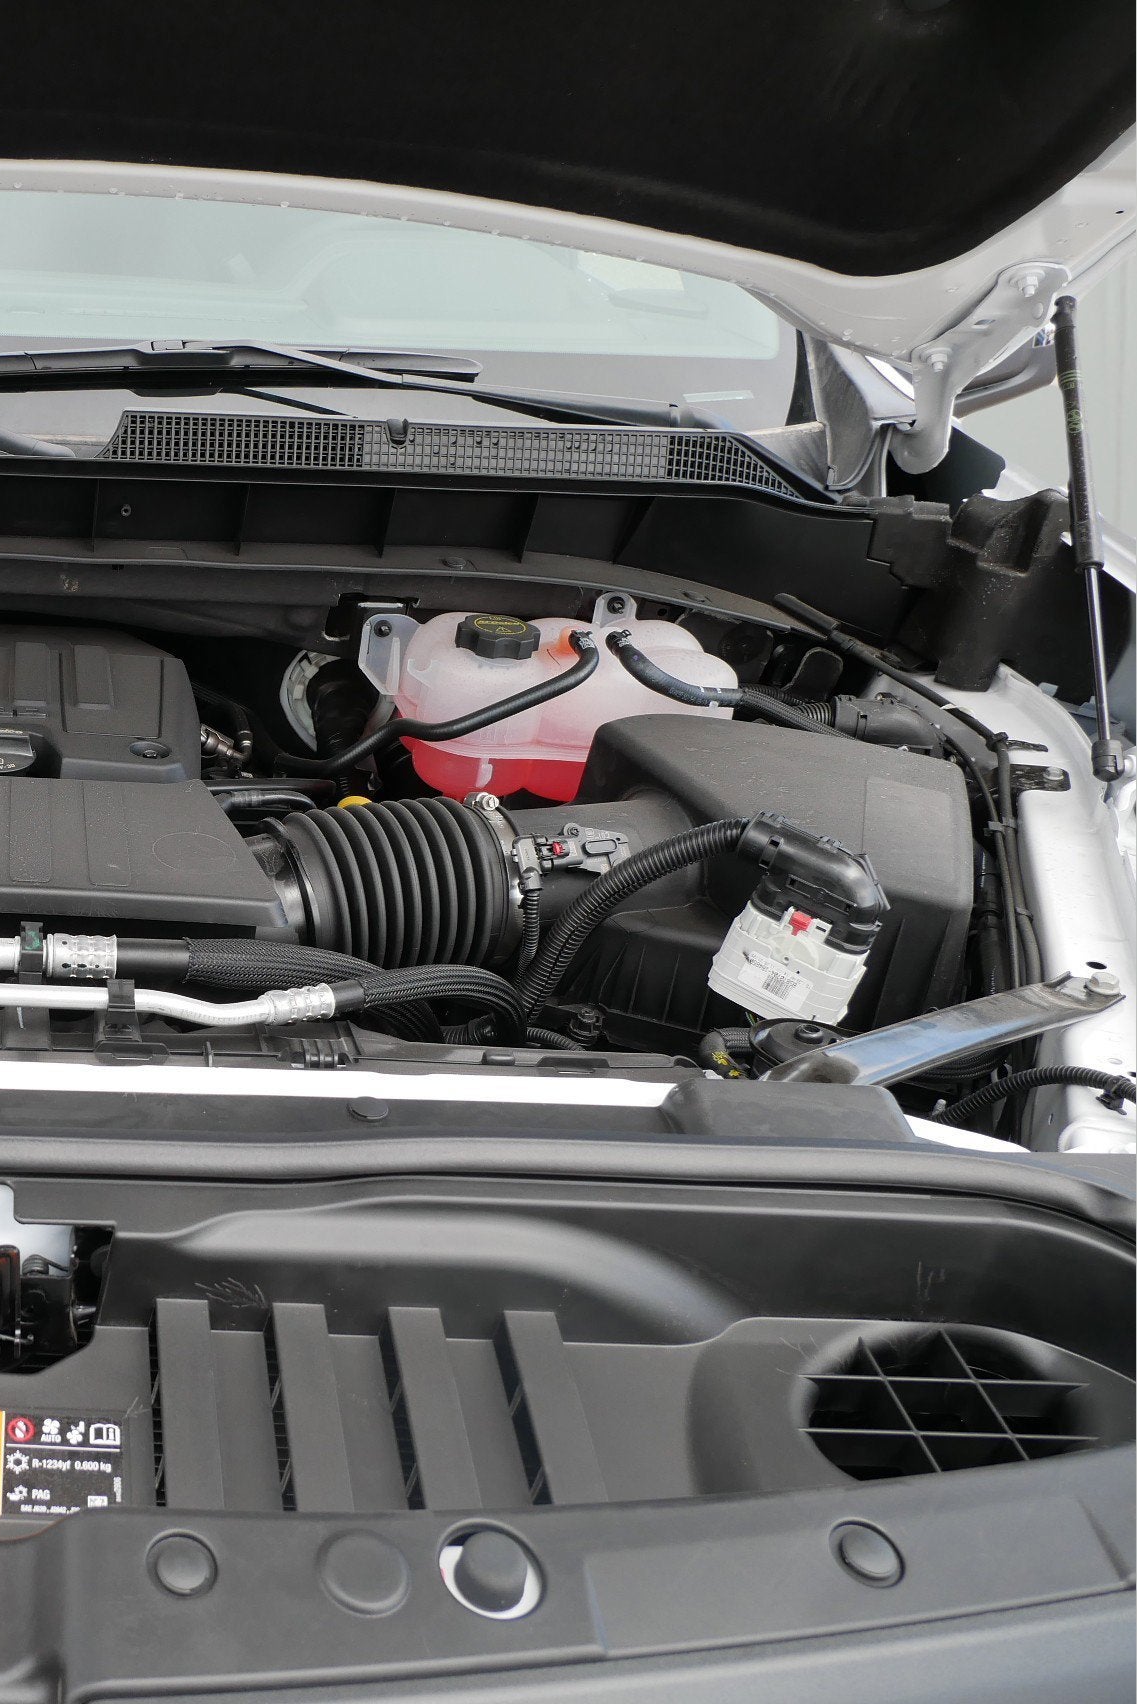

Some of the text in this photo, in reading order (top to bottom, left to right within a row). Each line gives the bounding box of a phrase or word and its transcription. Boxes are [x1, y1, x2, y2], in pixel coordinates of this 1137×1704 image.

[40, 1433, 62, 1443] AUTO
[31, 1458, 112, 1473] R-1234yf 0.600 kg
[31, 1488, 51, 1500] PAG
